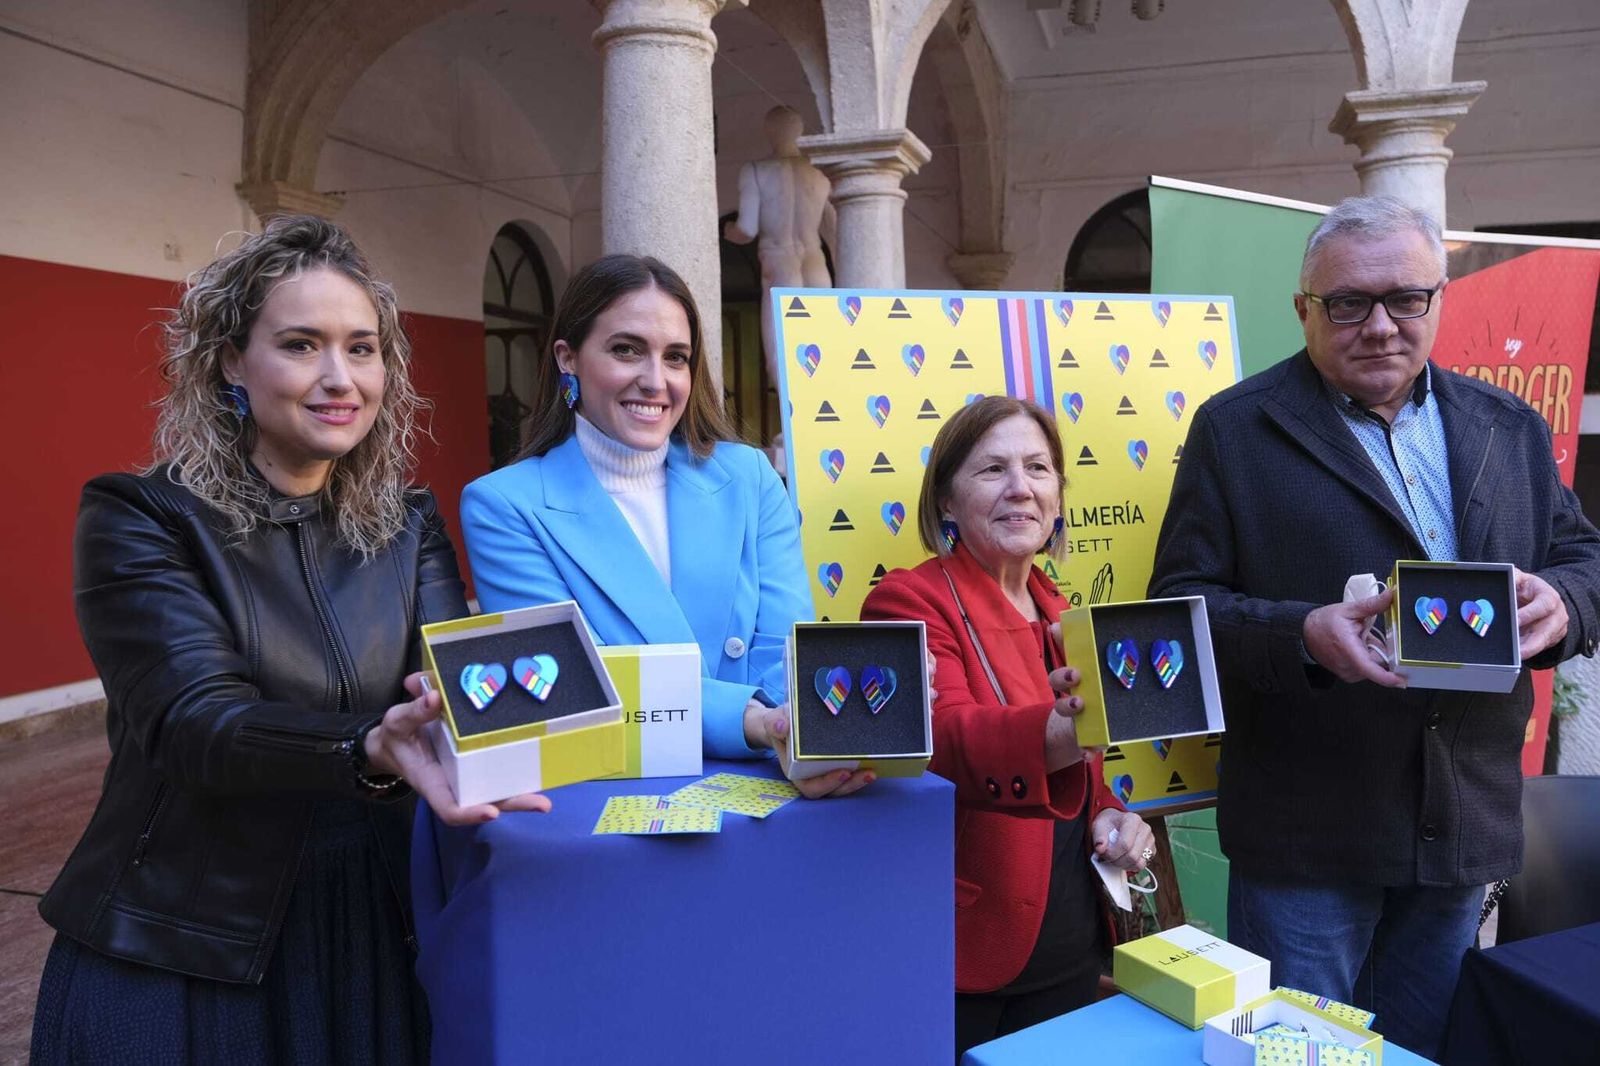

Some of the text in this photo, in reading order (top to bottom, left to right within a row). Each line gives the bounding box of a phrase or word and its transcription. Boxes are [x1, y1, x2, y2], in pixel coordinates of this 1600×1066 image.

[1065, 500, 1145, 529] LMERÍA
[1066, 537, 1113, 554] SETT
[1158, 941, 1220, 966] LAUSETT
